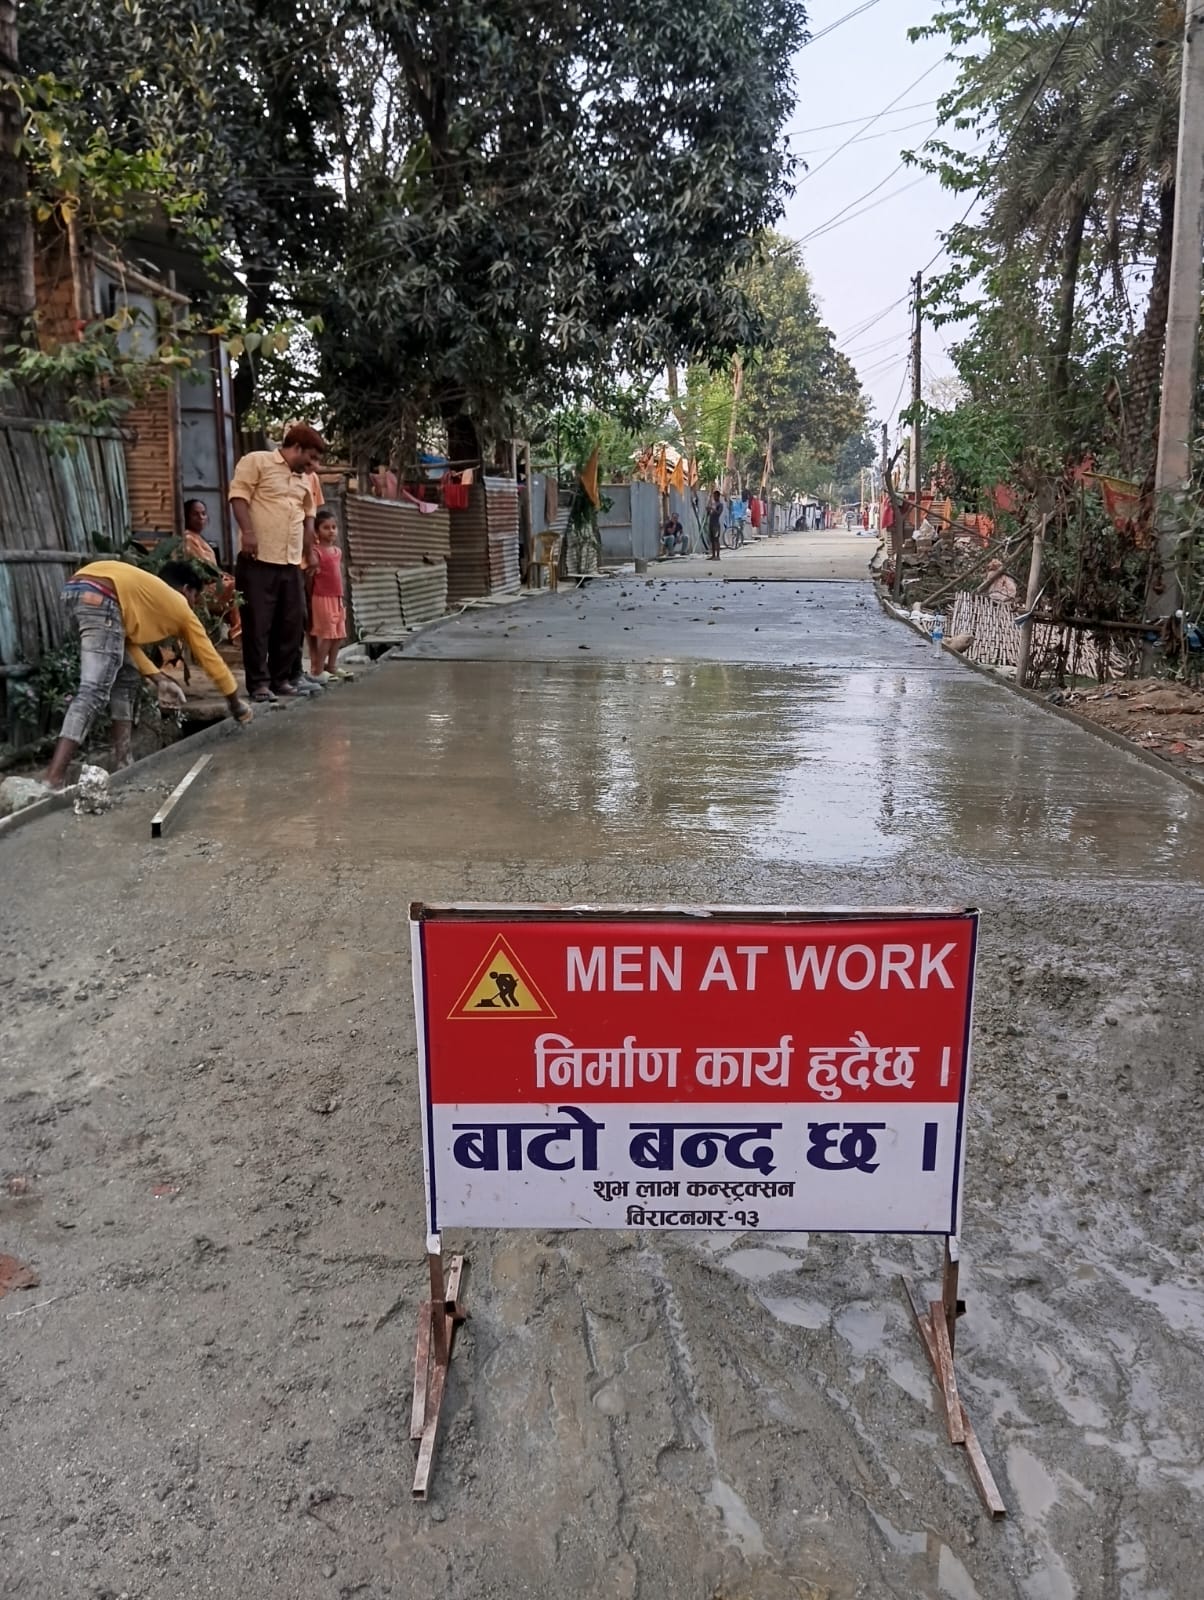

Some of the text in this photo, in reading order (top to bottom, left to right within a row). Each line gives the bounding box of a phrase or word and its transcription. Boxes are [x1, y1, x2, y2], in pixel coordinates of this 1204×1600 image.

[567, 943, 956, 991] MEN AT WORK
[534, 1033, 681, 1087] निर्माण
[695, 1035, 794, 1087] कार्य
[807, 1031, 920, 1100] हुदैछ
[452, 1106, 604, 1171] बाटो
[629, 1122, 781, 1175] बन्द
[806, 1122, 885, 1174] छ
[593, 1181, 796, 1202] शुभ लाभ कन्स्ट्रक्सन
[626, 1205, 760, 1227] विराटनगर-१३
